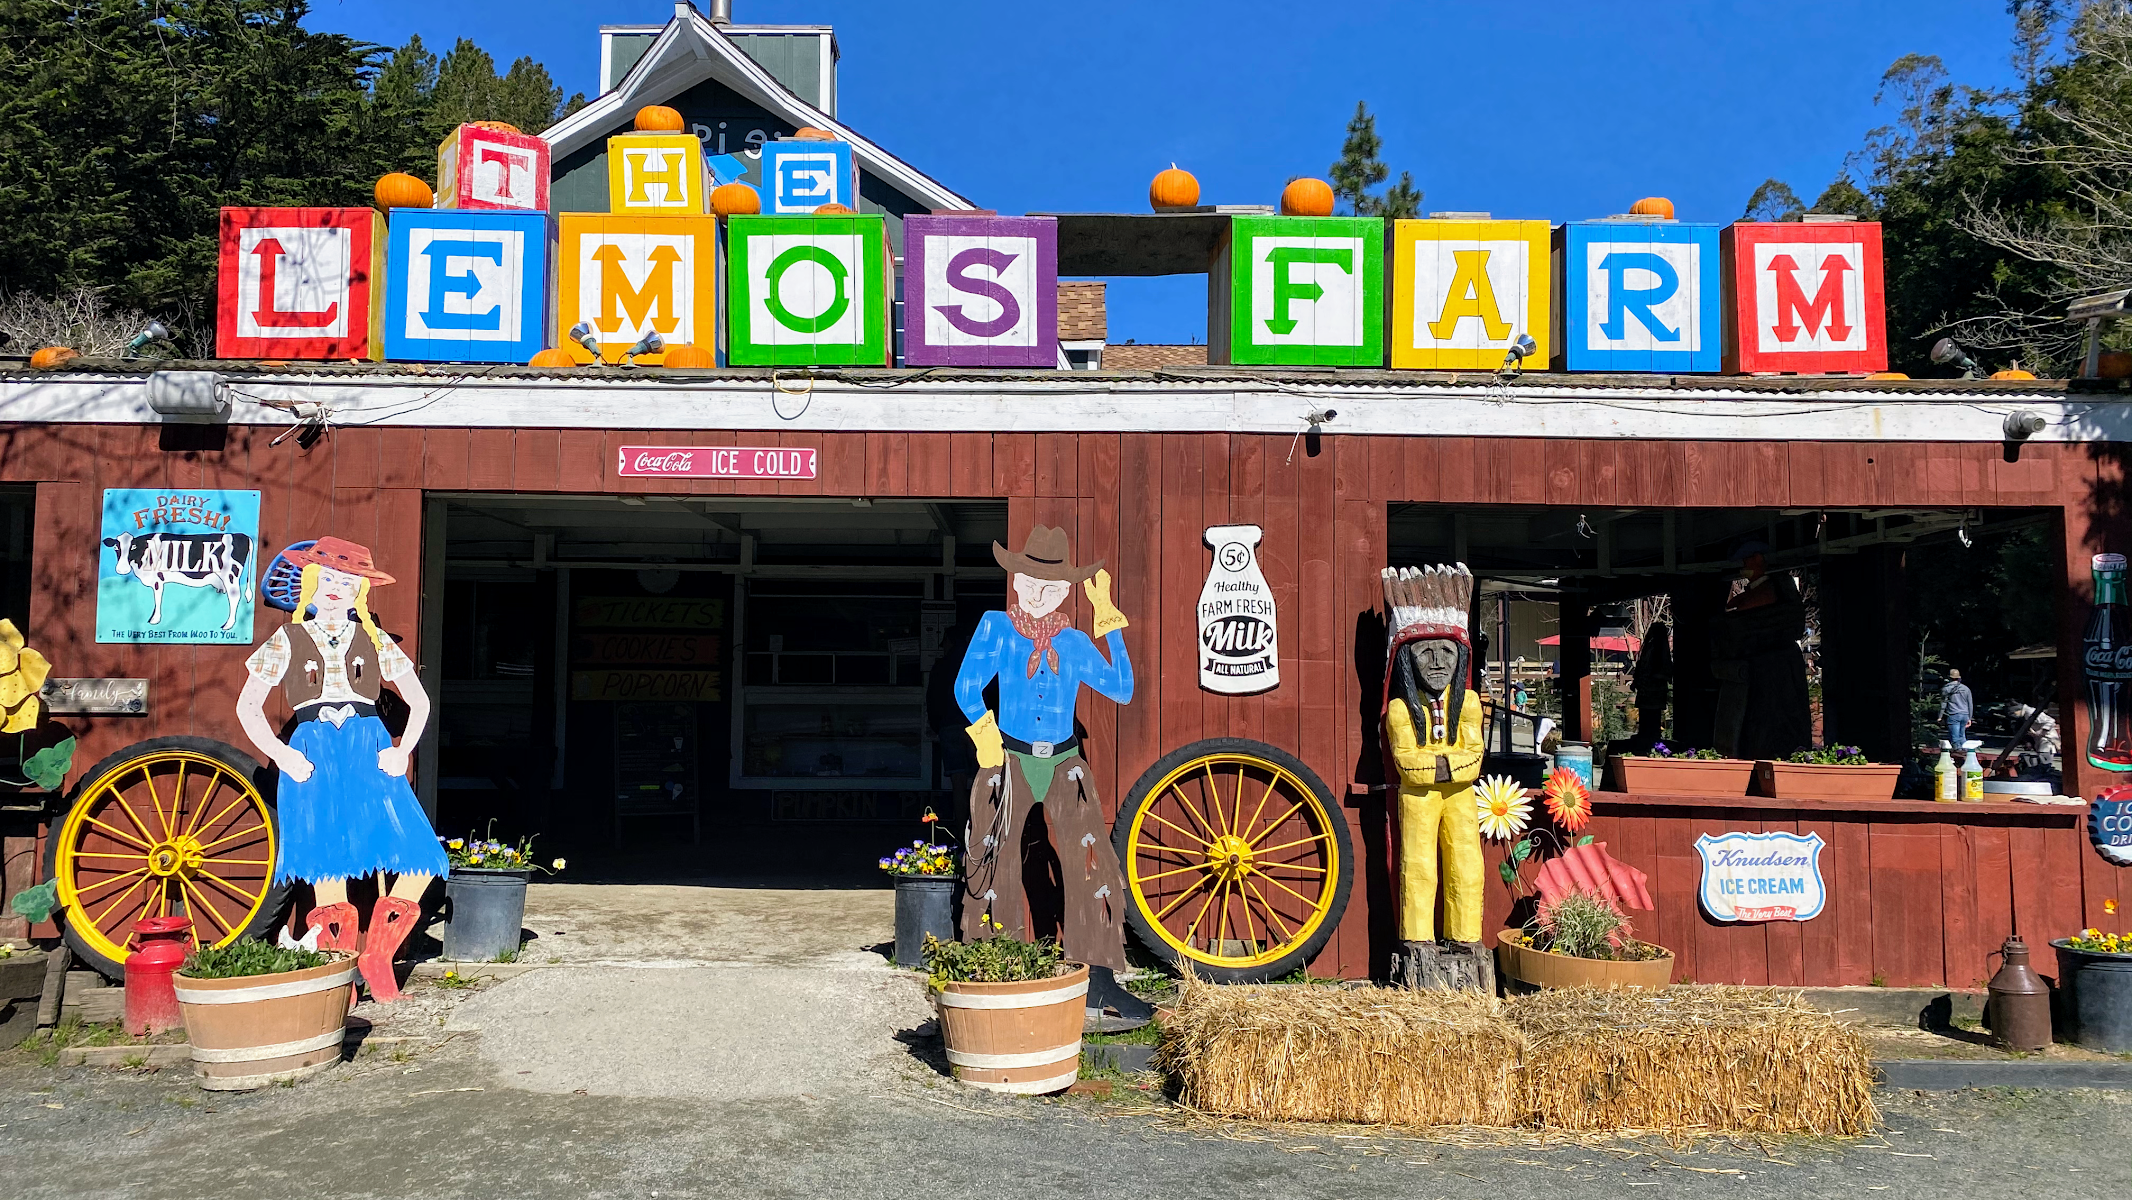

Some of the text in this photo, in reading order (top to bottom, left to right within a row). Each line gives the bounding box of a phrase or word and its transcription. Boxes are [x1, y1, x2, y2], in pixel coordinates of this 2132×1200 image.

[250, 236, 1856, 343] LEMOS FARM
[711, 450, 740, 475] ICE
[753, 451, 802, 476] COLD
[156, 494, 211, 509] DAIRY
[132, 506, 231, 532] FRESH!
[143, 539, 224, 573] MILK
[1224, 549, 1245, 567] 5¢
[1213, 580, 1260, 595] Healthy
[602, 601, 717, 626] TICKETS
[1201, 598, 1273, 619] FARM FRESH
[1204, 620, 1274, 651] Milk
[602, 636, 698, 662] COOKIES
[1215, 663, 1264, 676] ALL NATURAL
[602, 672, 709, 698] POPCORN
[1712, 849, 1809, 867] Knudsen
[1720, 877, 1805, 895] ICE CREAM
[1738, 907, 1793, 919] The Very Best
